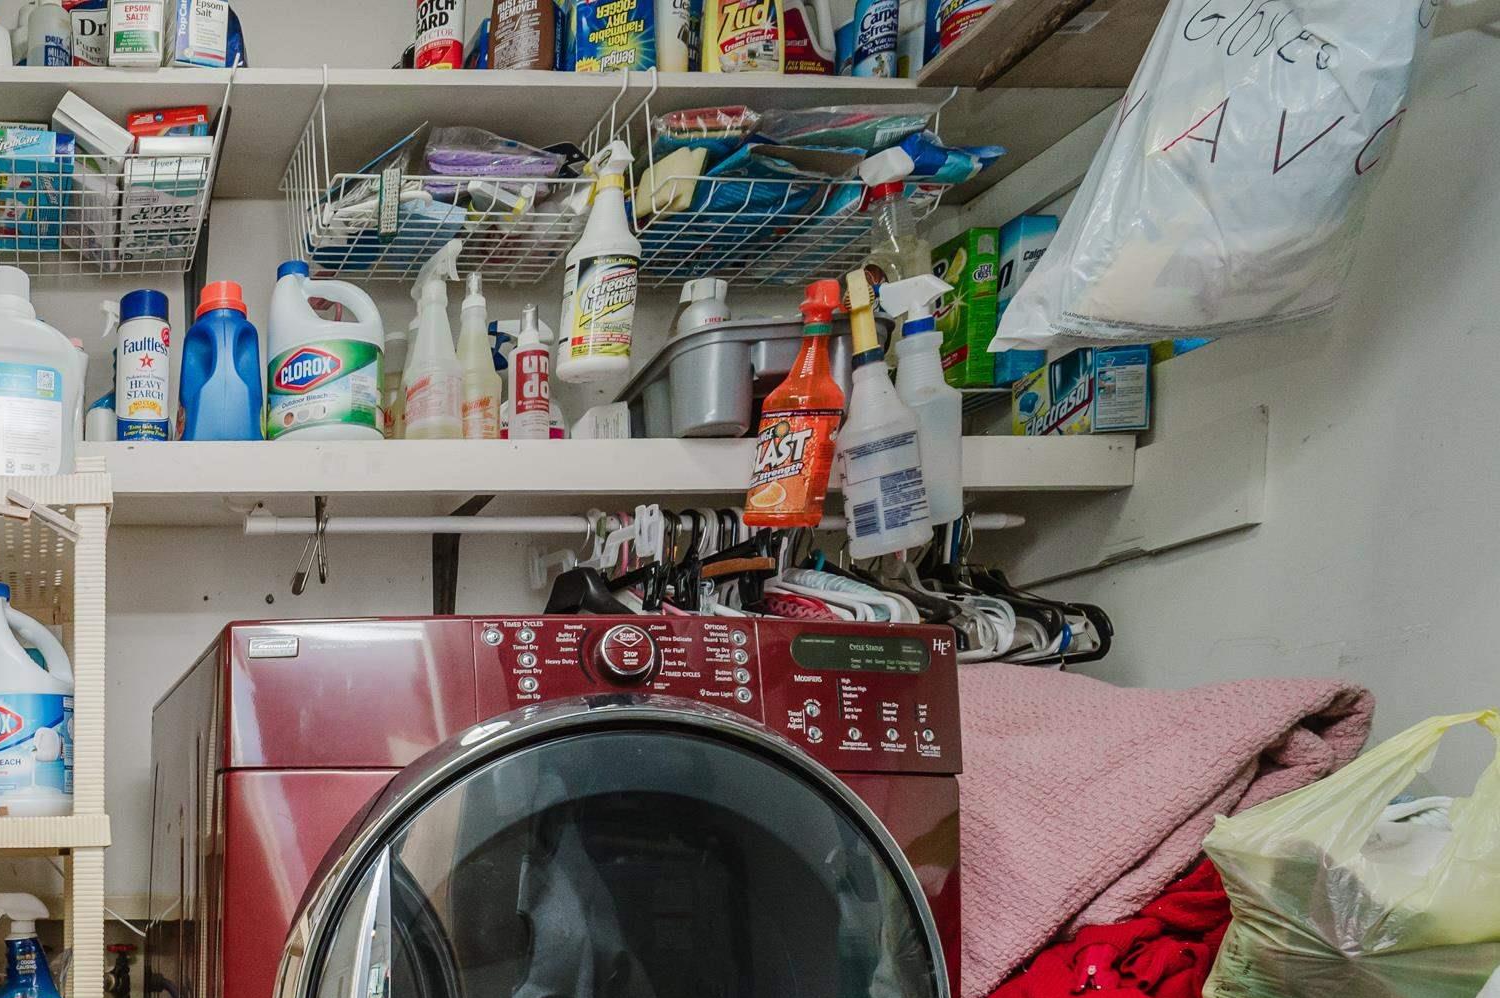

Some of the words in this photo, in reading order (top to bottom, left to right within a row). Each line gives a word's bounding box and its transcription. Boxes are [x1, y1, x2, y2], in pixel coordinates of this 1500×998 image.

[124, 5, 151, 13] EPSOM
[195, 8, 211, 17] Salt
[196, 0, 224, 10] Epsom
[499, 1, 538, 22] REMOVER
[126, 13, 149, 21] SALTS
[606, 14, 628, 29] DRY
[719, 0, 770, 37] Zud
[589, 20, 644, 43] Flammable
[607, 34, 628, 46] Non
[600, 48, 636, 67] Bengal
[124, 337, 168, 356] Faultless
[281, 356, 332, 384] CLOROX
[522, 355, 548, 374] un
[130, 380, 162, 390] HEAVY
[126, 390, 164, 401] STARCH
[306, 393, 329, 401] Bleach
[1025, 374, 1090, 436] Electrasol
